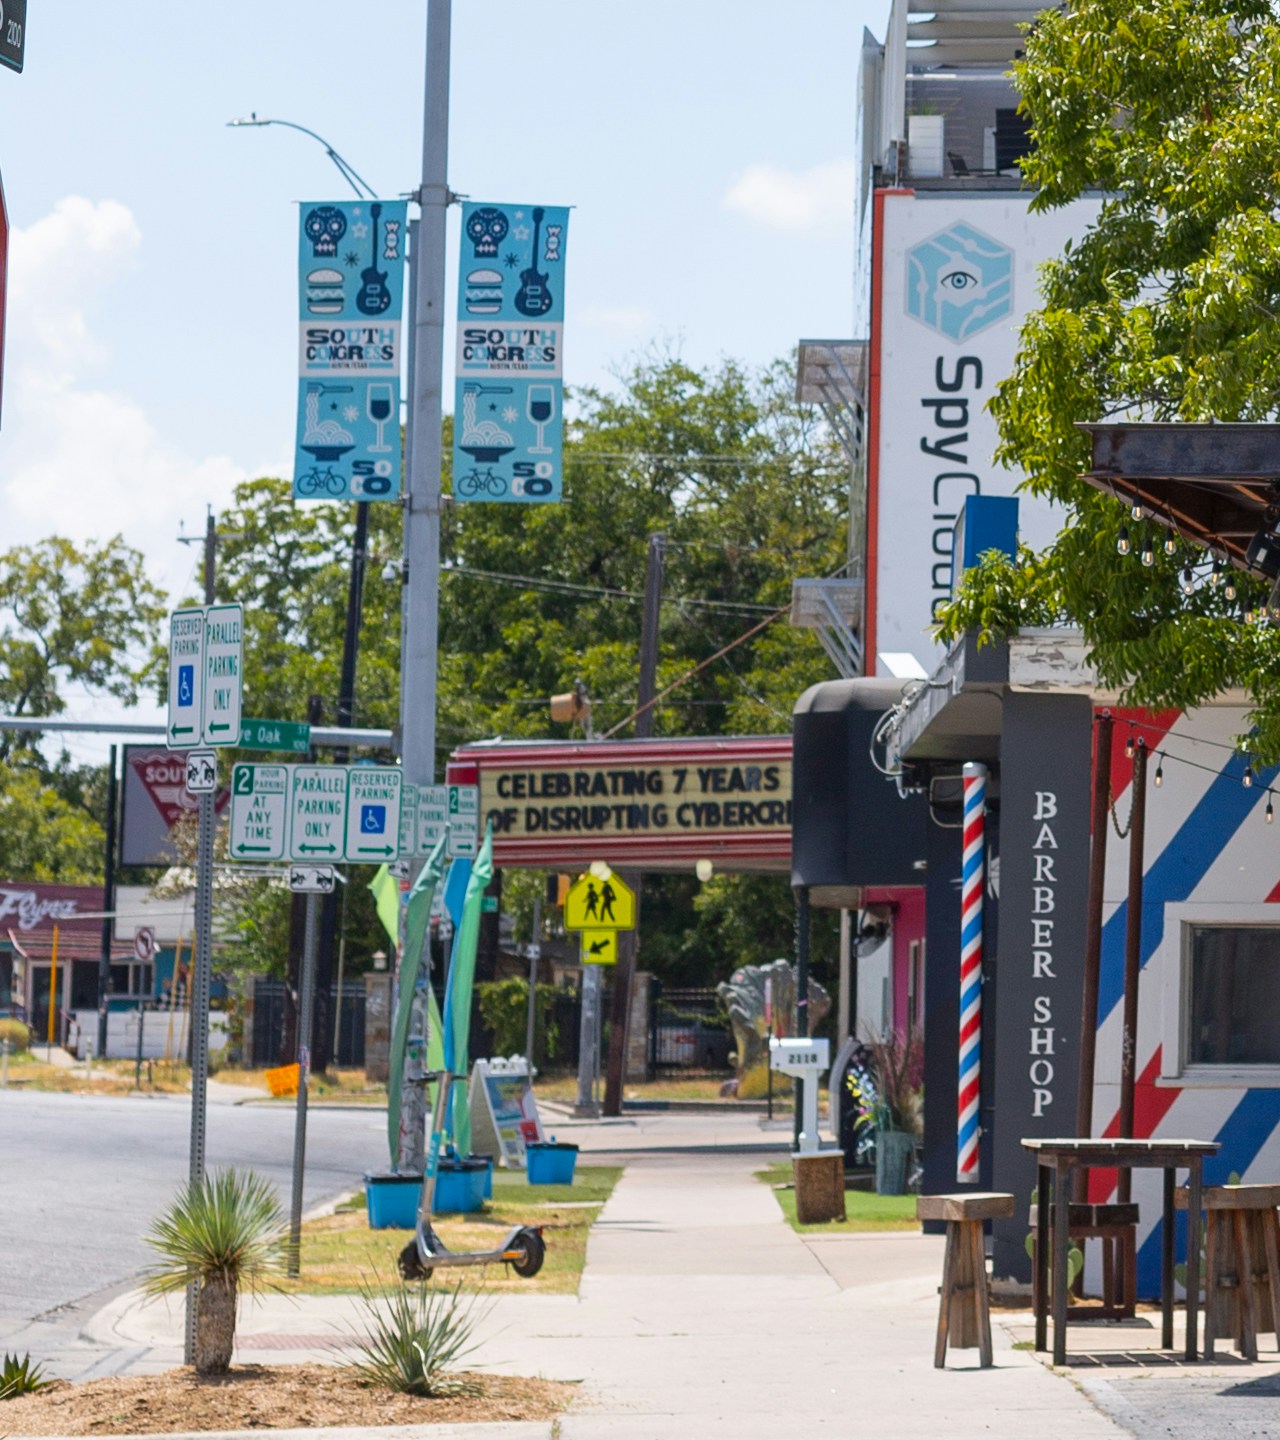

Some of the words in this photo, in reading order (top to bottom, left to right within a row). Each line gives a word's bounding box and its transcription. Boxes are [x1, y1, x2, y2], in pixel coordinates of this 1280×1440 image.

[6, 18, 23, 49] 2100
[306, 328, 395, 345] SOUTH
[463, 328, 557, 346] SOUTH
[306, 345, 394, 361] CONGRESS
[463, 345, 557, 362] CONGRESS
[173, 618, 202, 637] RESERVED
[207, 621, 241, 646] PARALLEL
[174, 639, 200, 657] PARKING
[208, 655, 238, 678] PARKING
[213, 688, 232, 711] ONLY
[257, 726, 281, 744] Oak
[238, 767, 251, 793] 2
[260, 770, 280, 778] HOUR
[351, 773, 399, 787] RESERVED
[496, 768, 664, 800] CELEBRATING
[671, 768, 687, 794] 7
[696, 766, 781, 795] YEARS
[254, 780, 285, 790] PARKING
[294, 777, 346, 794] PARALLEL
[354, 787, 395, 801] PARKING
[252, 796, 267, 809] AT
[297, 799, 342, 816] PARKING
[450, 790, 458, 810] 2
[246, 811, 272, 825] ANY
[488, 806, 519, 833] OF
[524, 803, 669, 832] DISRUPTING
[244, 826, 273, 840] TIME
[304, 821, 332, 838] ONLY
[1031, 791, 1058, 978] BARBER
[1029, 996, 1055, 1118] SHOP
